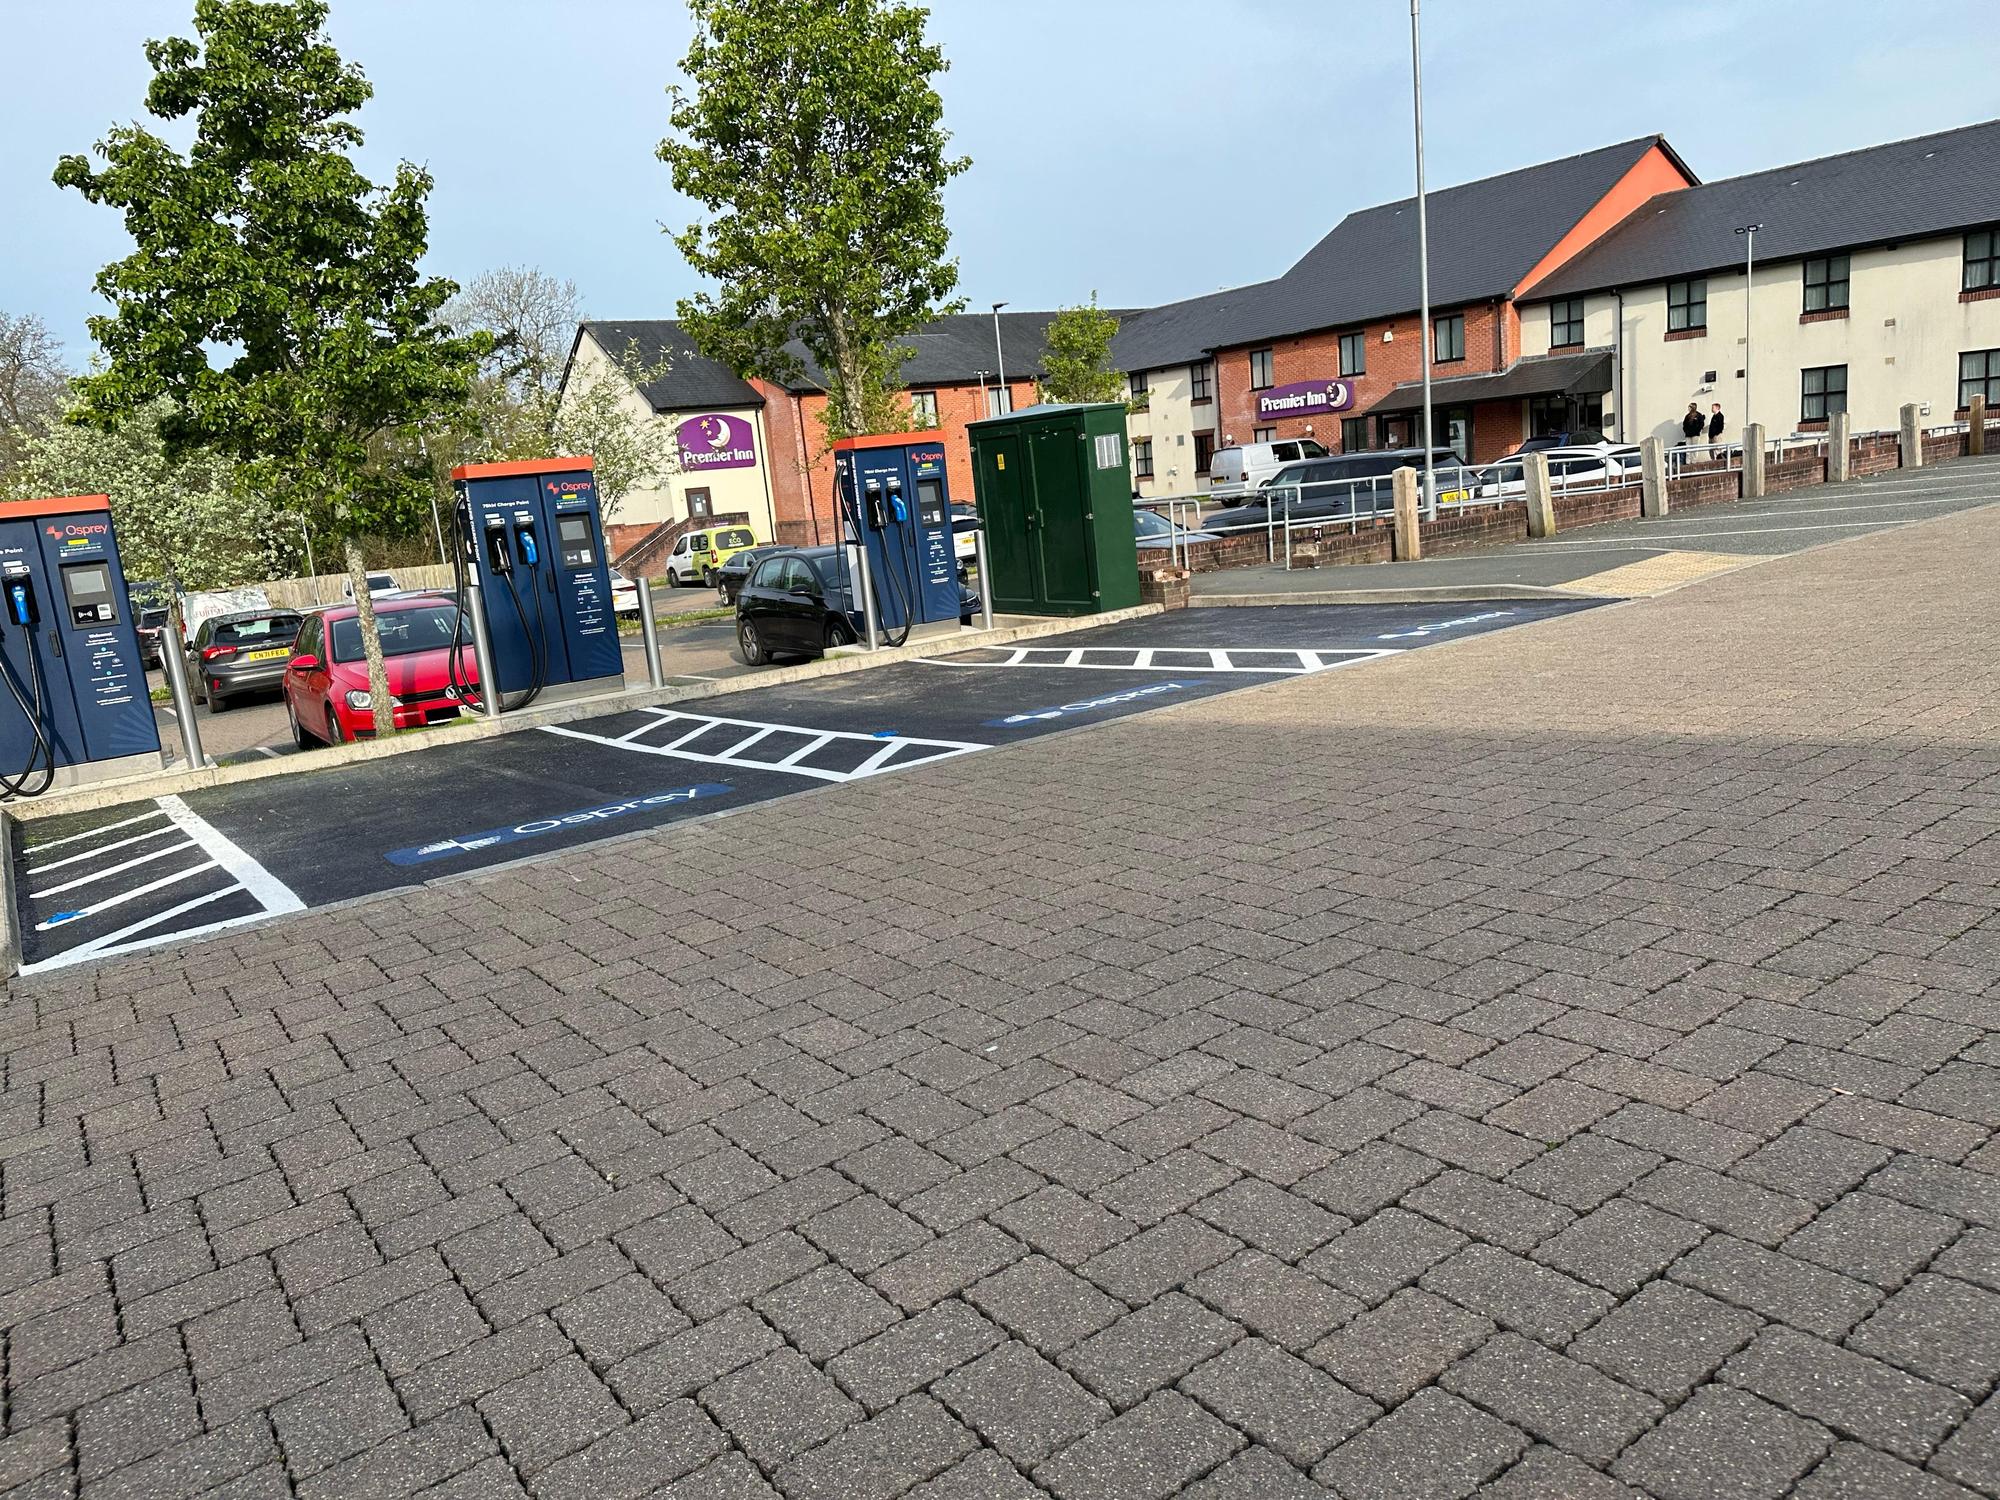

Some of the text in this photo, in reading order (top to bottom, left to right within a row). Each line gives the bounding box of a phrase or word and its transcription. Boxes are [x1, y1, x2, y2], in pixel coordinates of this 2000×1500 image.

[1261, 391, 1327, 412] Premier Inn
[684, 448, 754, 464] Premier Inn
[560, 482, 592, 492] Osprey
[65, 525, 108, 537] Osprey
[469, 521, 478, 544] CHARGE
[728, 537, 742, 545] ECO
[513, 788, 697, 833] Osprey
